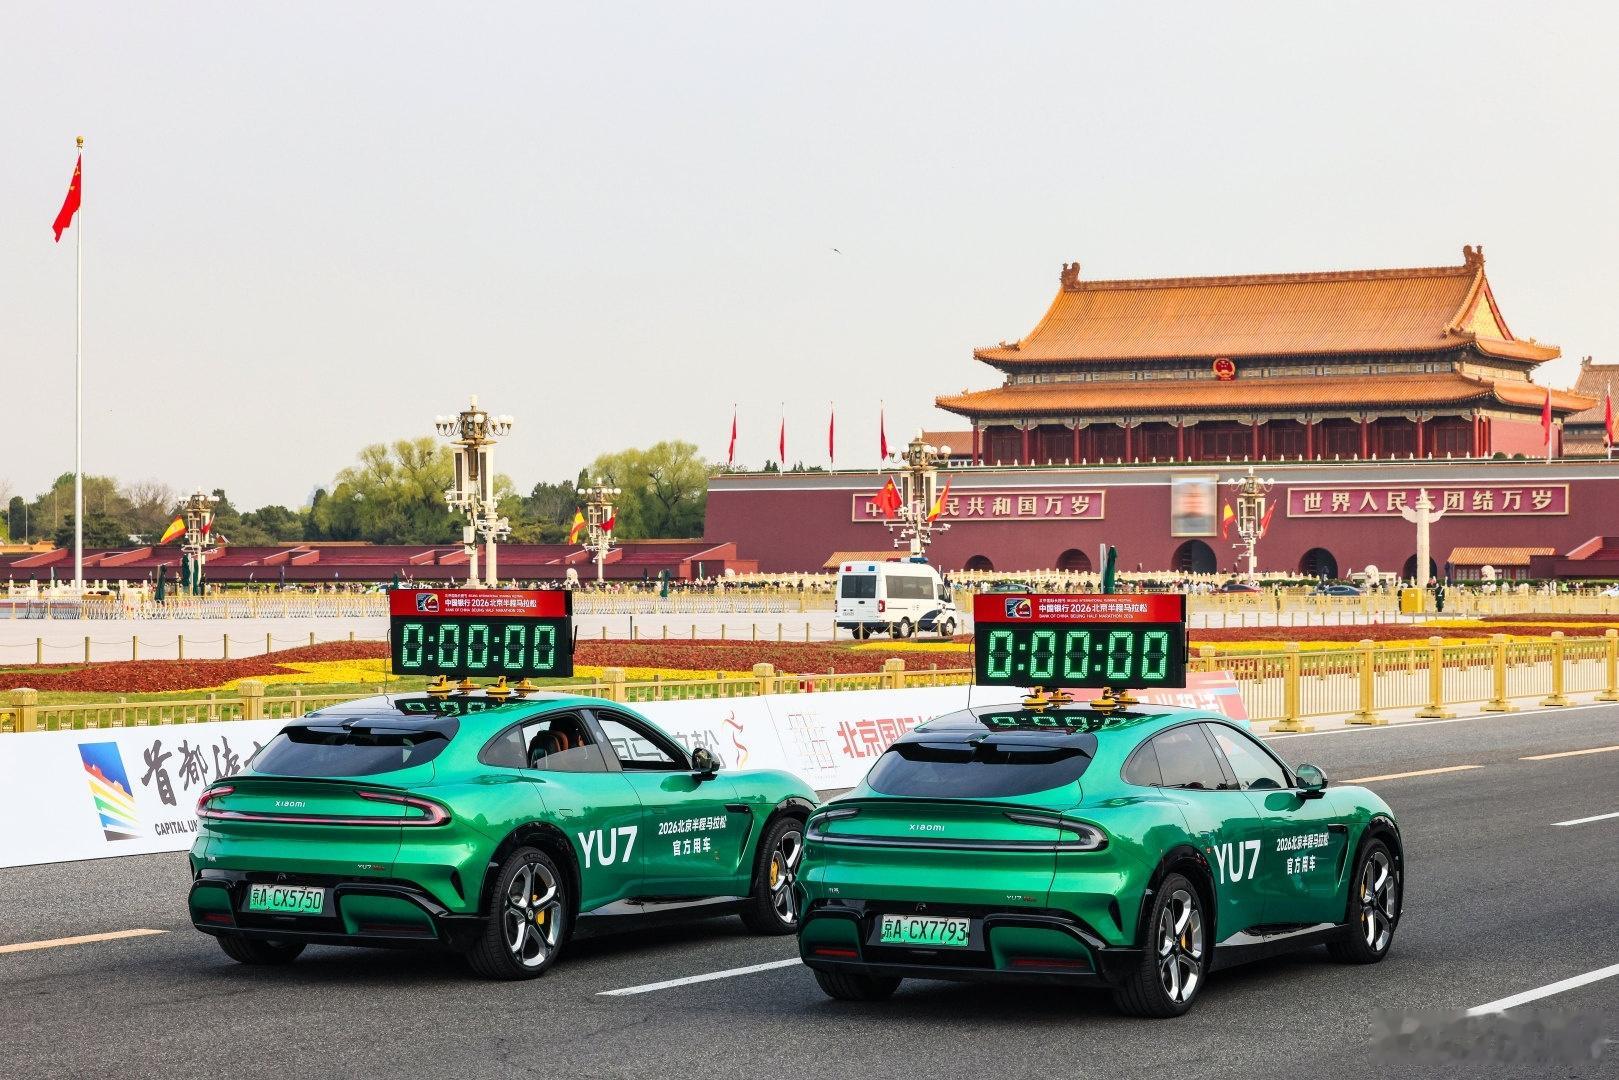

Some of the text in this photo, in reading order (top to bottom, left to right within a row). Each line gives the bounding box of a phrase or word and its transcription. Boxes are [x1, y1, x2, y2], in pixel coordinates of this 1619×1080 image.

[865, 496, 1090, 517] 中民共和国万岁
[445, 599, 470, 607] 中国银行
[1039, 603, 1069, 613] 中国银行
[402, 623, 556, 670] 0:00:00
[987, 630, 1169, 679] 0:00:00
[837, 716, 932, 758] 北京国
[141, 735, 264, 807] 首都体
[154, 820, 188, 837] CAPITAL
[658, 815, 727, 835] 2026北京半程马拉松
[577, 825, 638, 869] YU7
[672, 836, 711, 857] 官方用车
[1213, 839, 1261, 885] YU7
[1286, 855, 1316, 875] 官方用车
